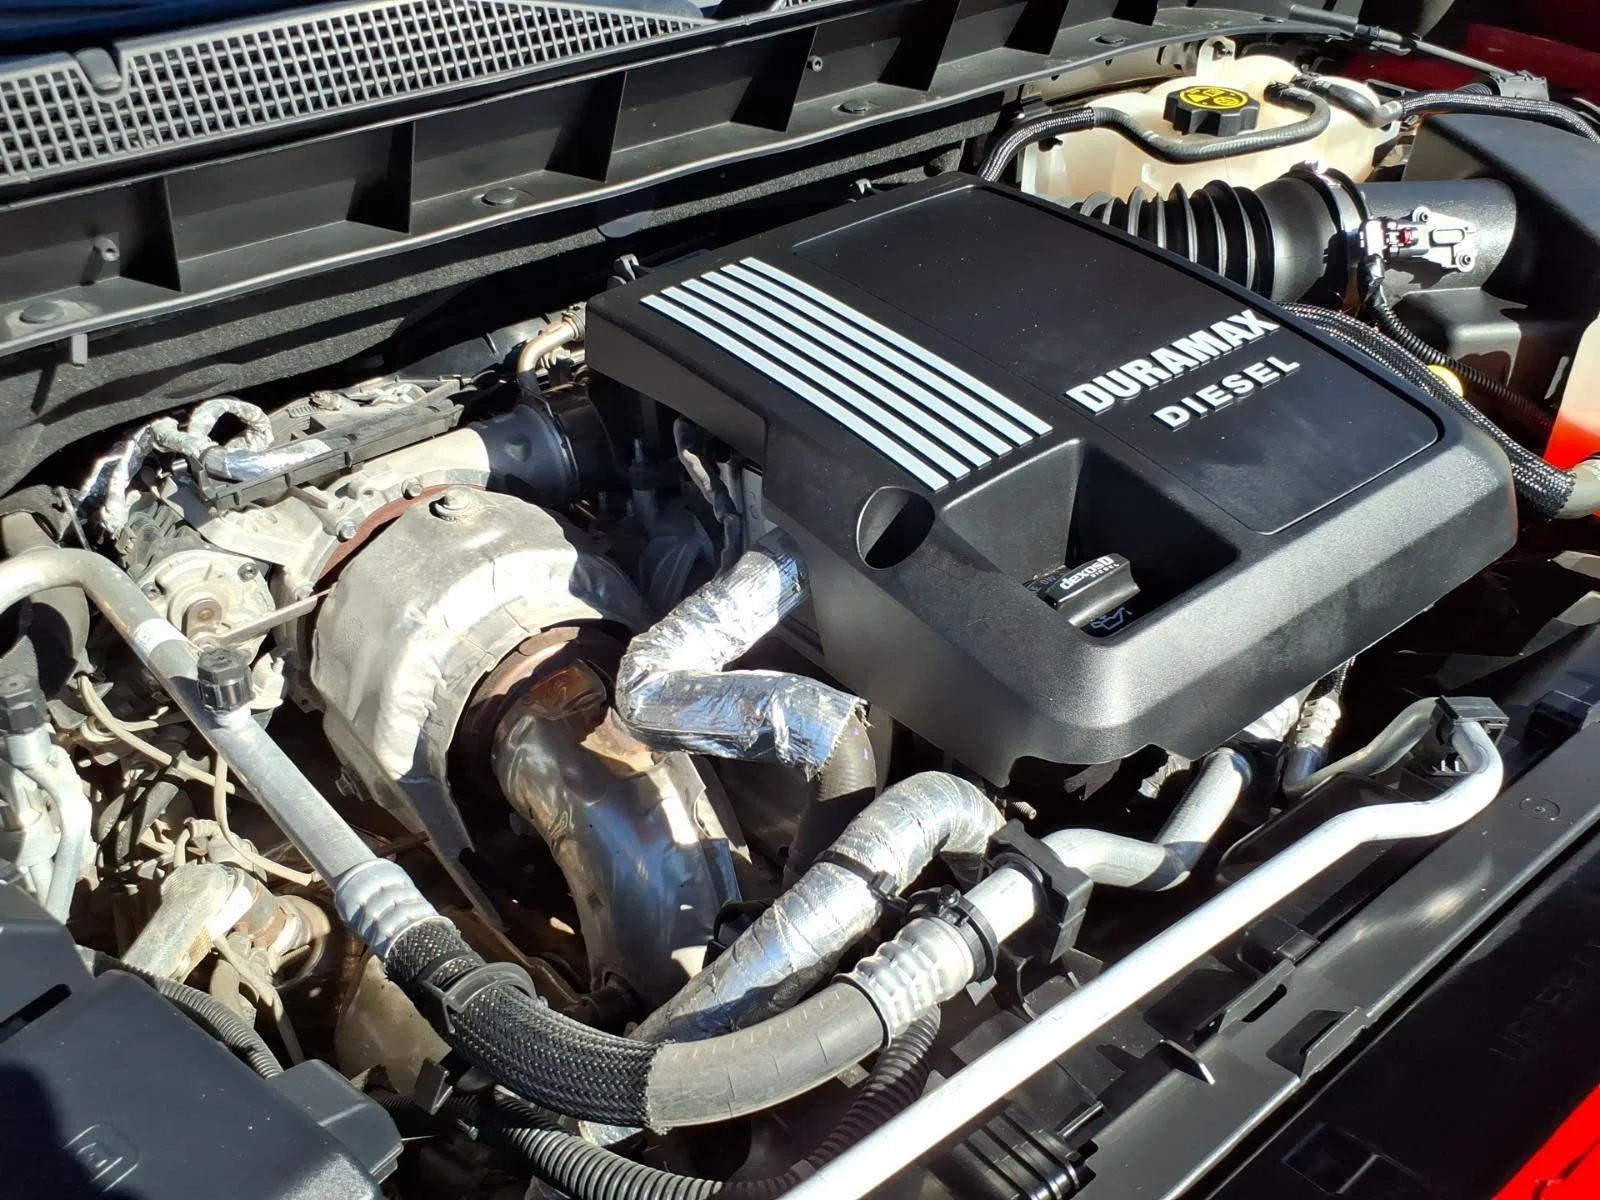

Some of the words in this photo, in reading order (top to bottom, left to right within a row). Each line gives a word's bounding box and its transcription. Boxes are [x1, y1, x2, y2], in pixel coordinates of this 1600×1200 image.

[1064, 309, 1280, 415] DURAMAX
[1152, 356, 1300, 431] DIESEL
[1060, 556, 1115, 590] dexosD
